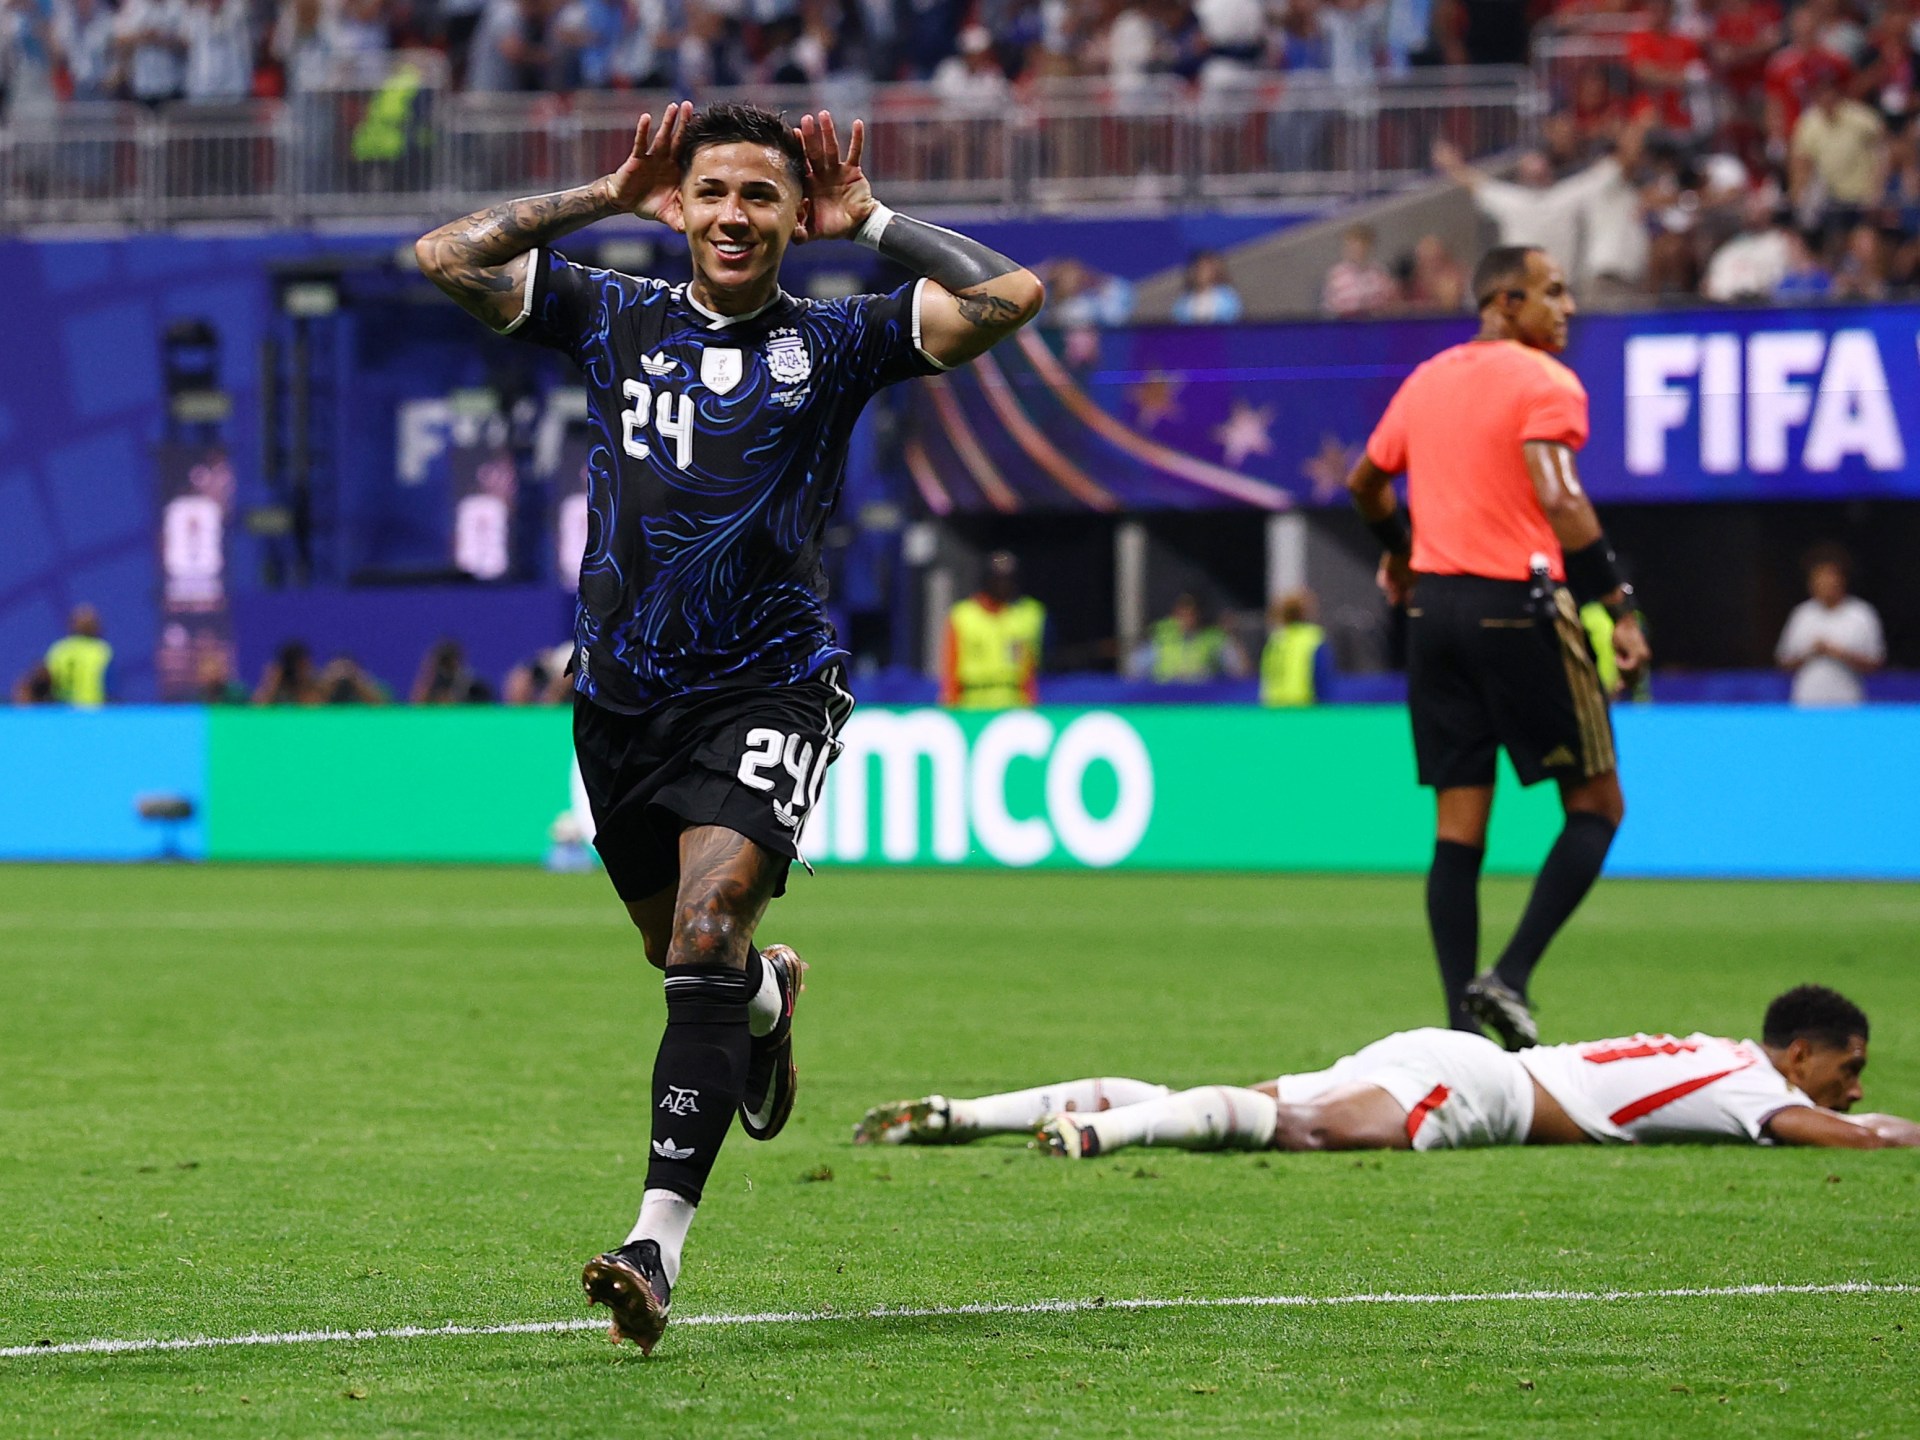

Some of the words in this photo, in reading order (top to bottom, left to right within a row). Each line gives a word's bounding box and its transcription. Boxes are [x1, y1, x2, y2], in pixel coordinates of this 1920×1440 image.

[777, 349, 801, 369] AFA
[621, 378, 694, 470] 24
[1624, 329, 1905, 476] FIFA
[571, 708, 1154, 867] mco
[738, 728, 813, 807] 24
[659, 1085, 700, 1116] AFA
